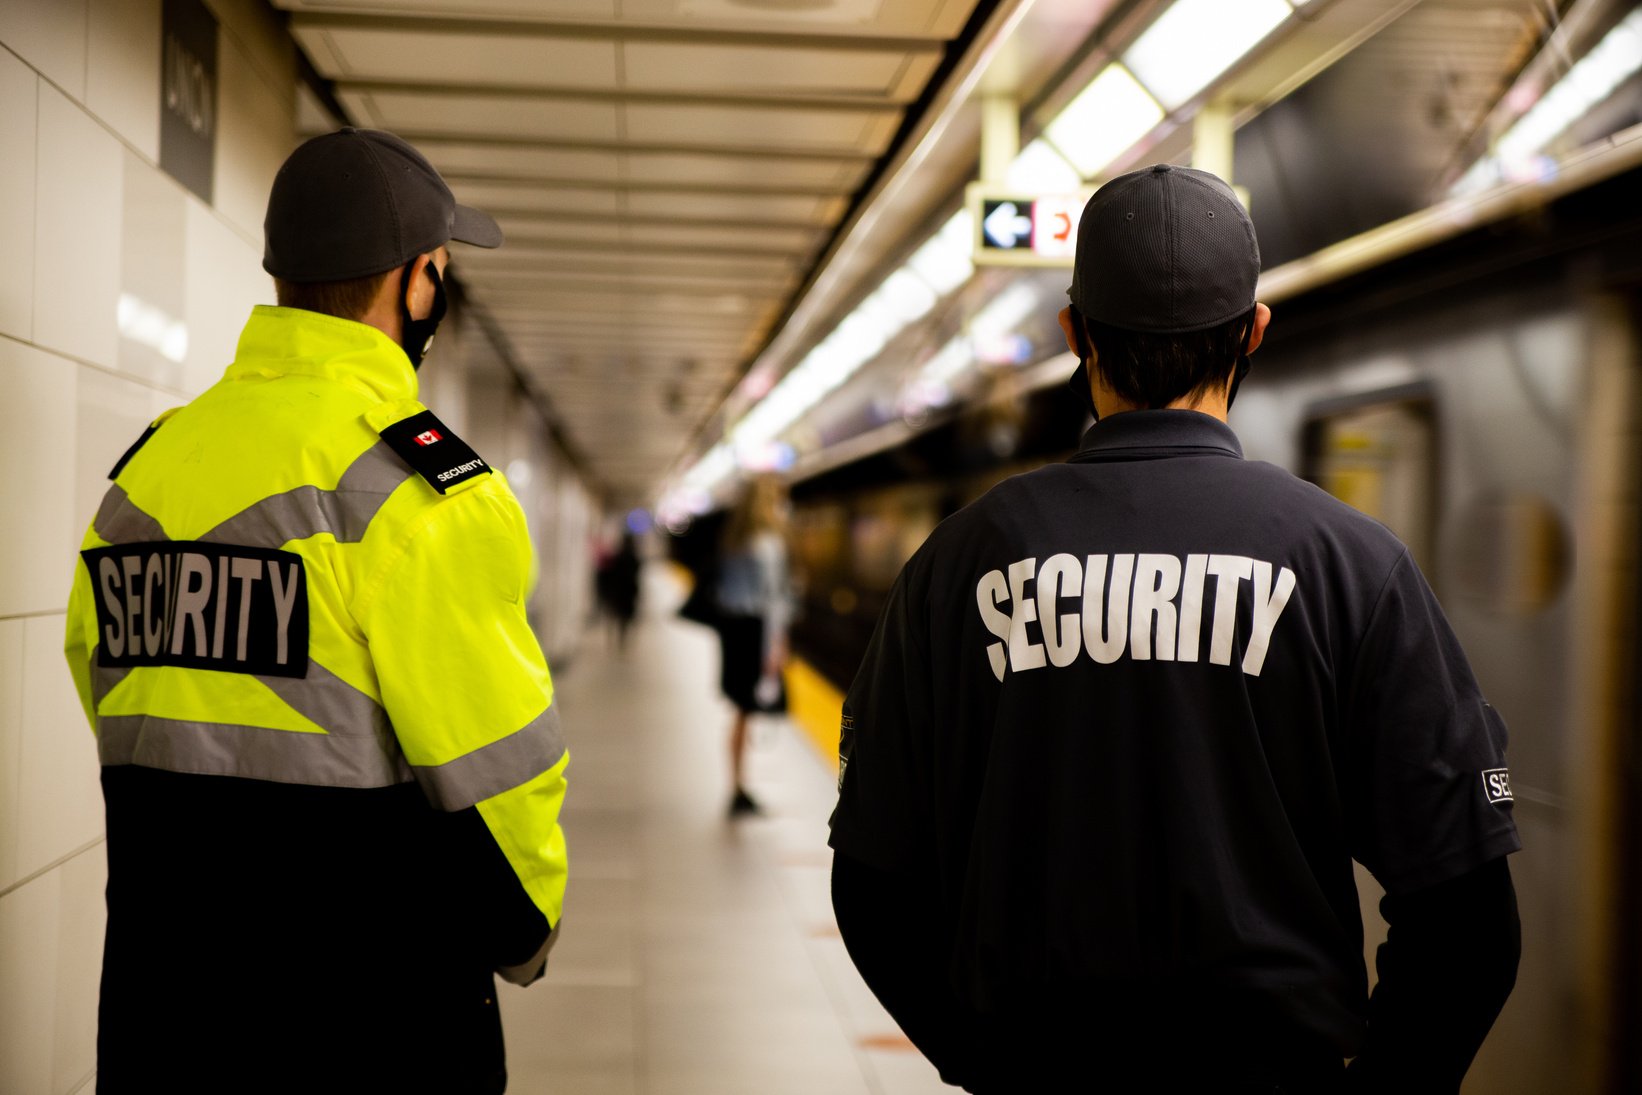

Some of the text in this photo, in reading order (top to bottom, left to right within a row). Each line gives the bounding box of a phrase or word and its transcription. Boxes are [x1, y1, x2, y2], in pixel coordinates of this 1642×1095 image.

[437, 459, 483, 482] SECURITY
[100, 552, 298, 664] SECURITY
[976, 553, 1297, 683] SECURITY
[1489, 773, 1512, 797] SE
